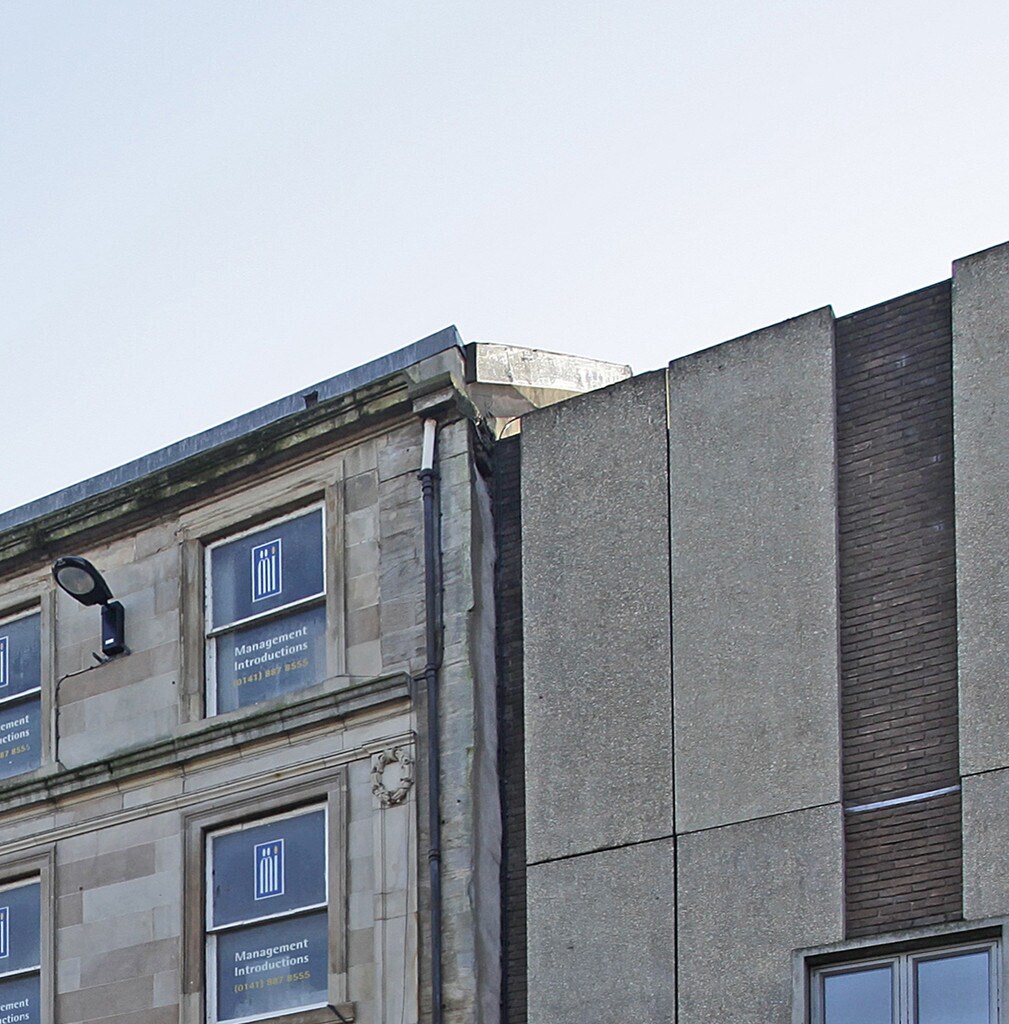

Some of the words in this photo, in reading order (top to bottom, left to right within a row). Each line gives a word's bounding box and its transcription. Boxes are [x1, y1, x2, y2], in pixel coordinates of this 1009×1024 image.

[234, 626, 308, 657] Management
[234, 641, 308, 671] Introductions
[235, 938, 309, 962] Management
[234, 955, 310, 977] Introductions
